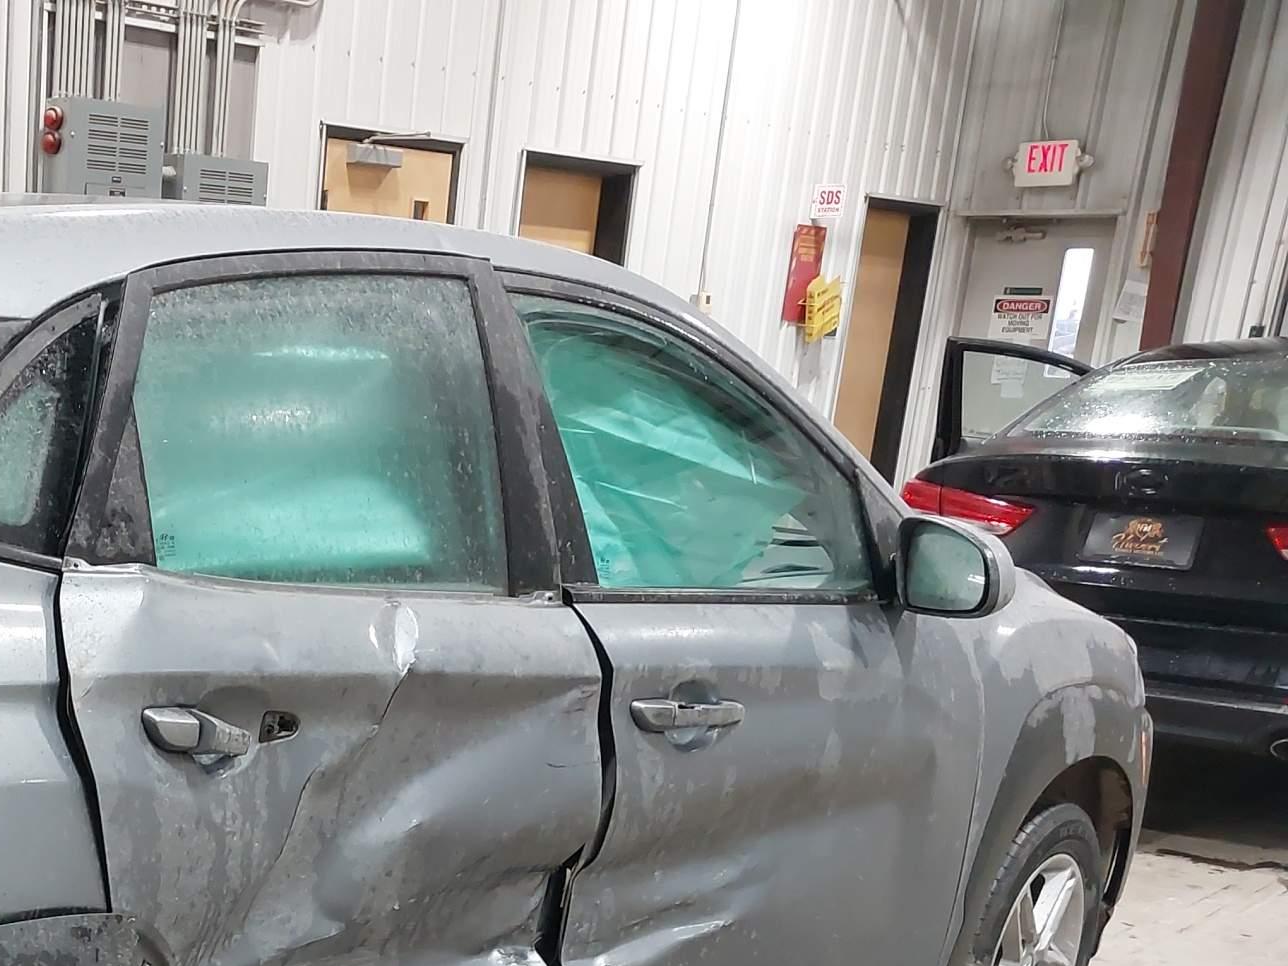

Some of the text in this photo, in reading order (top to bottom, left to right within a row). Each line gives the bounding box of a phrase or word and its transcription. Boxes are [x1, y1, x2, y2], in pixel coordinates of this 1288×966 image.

[1027, 143, 1069, 173] EXIT
[818, 190, 842, 205] SDS
[1002, 302, 1042, 311] DANGER
